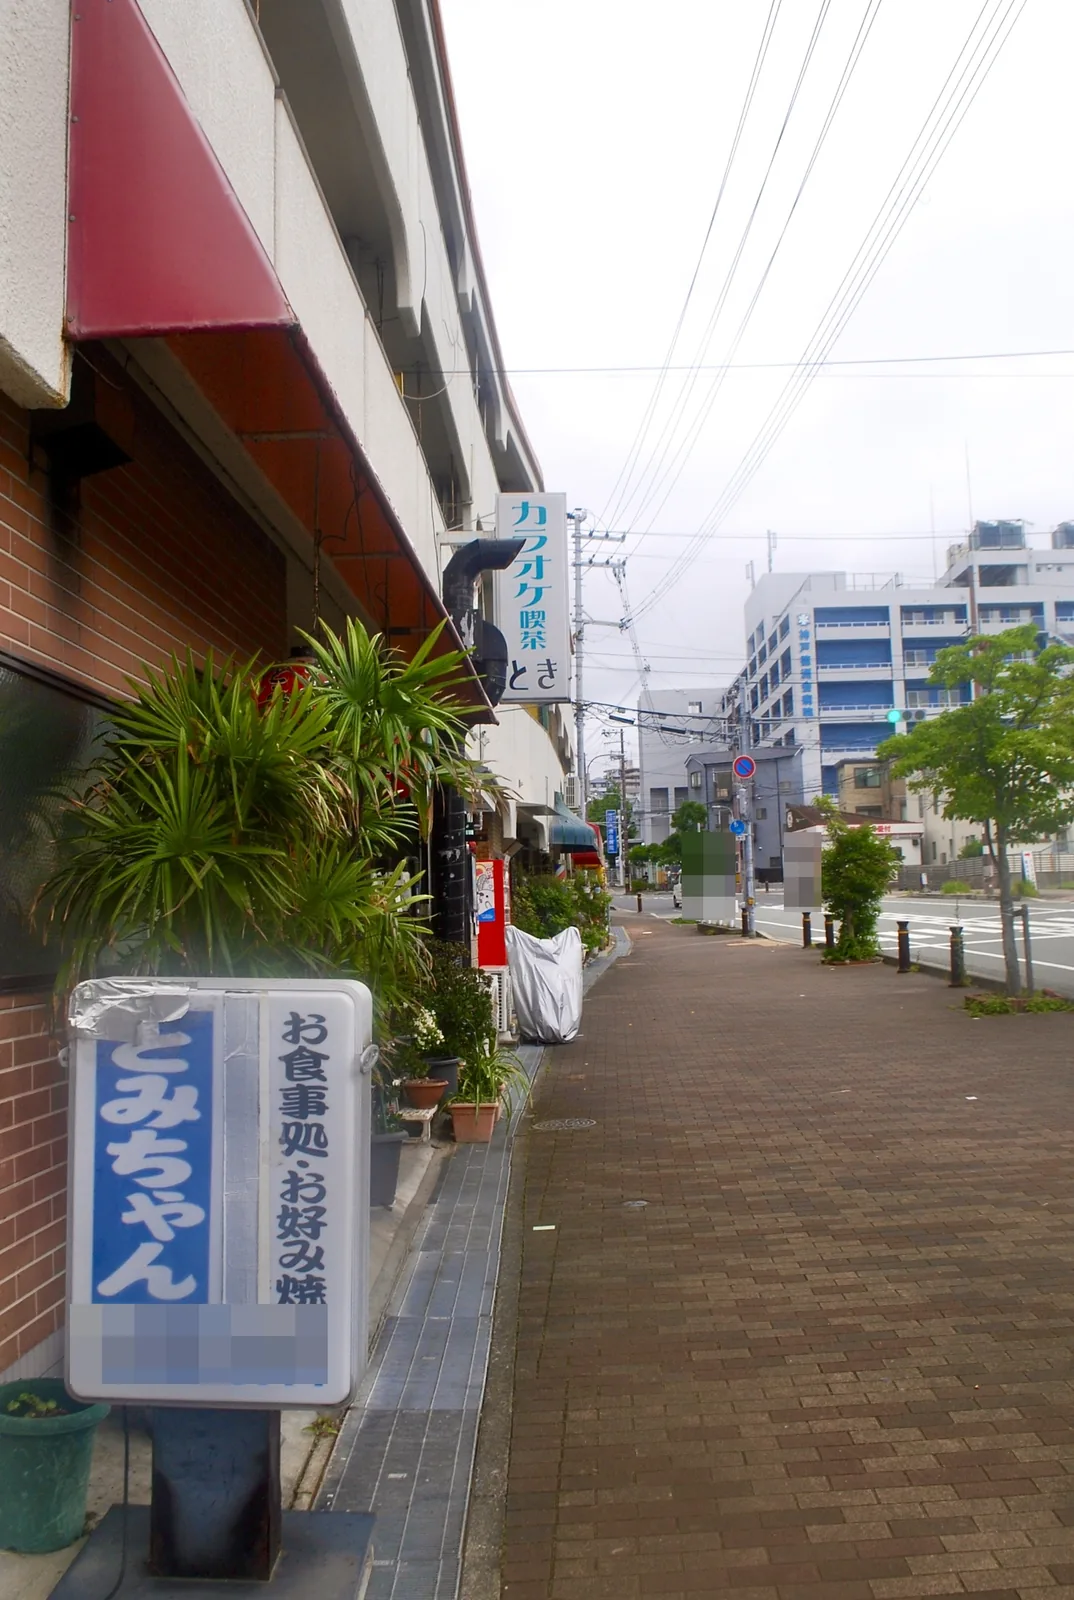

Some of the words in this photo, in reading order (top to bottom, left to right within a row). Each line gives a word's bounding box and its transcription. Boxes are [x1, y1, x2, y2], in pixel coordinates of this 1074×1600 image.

[511, 500, 552, 651] カラオケ喫茶
[508, 658, 558, 691] とき
[97, 1031, 206, 1301] とみちゃん
